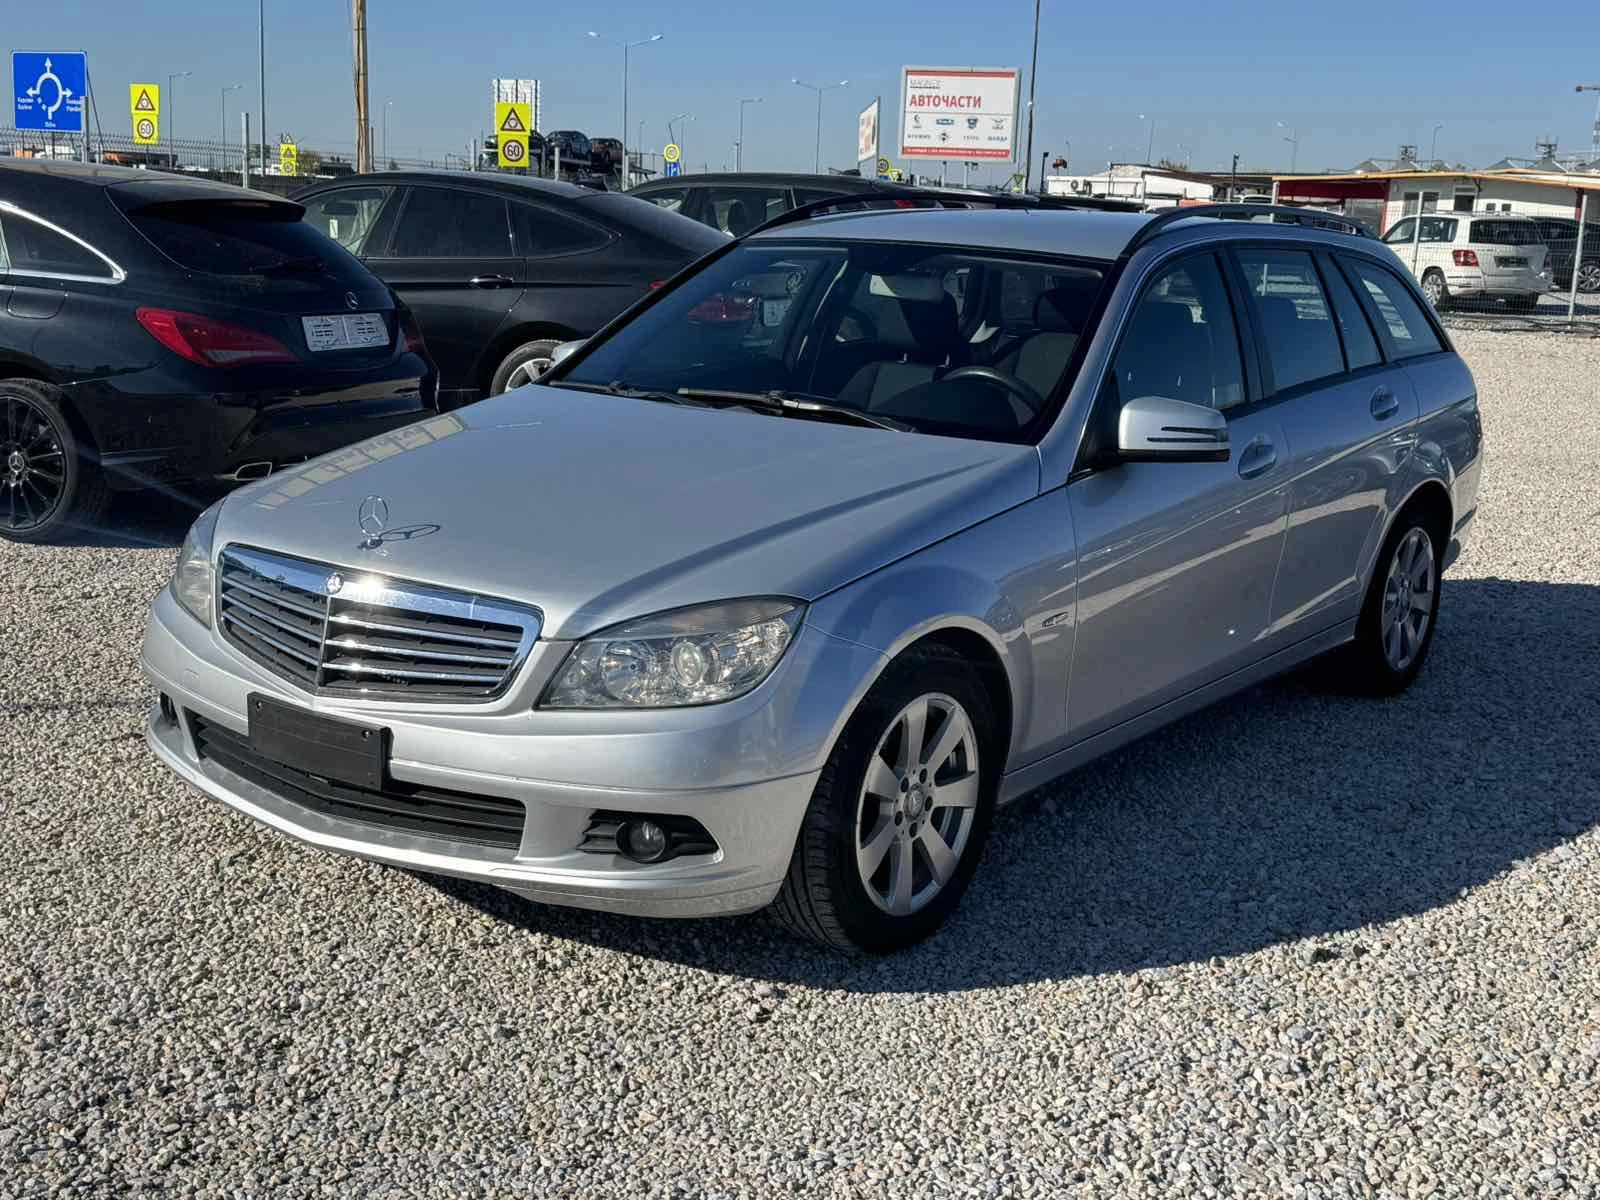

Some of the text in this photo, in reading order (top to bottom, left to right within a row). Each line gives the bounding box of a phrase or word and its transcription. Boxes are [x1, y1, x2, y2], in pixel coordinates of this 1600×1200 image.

[909, 94, 982, 109] АВТОЧАСТИ
[140, 122, 152, 135] 60
[506, 144, 520, 157] 60
